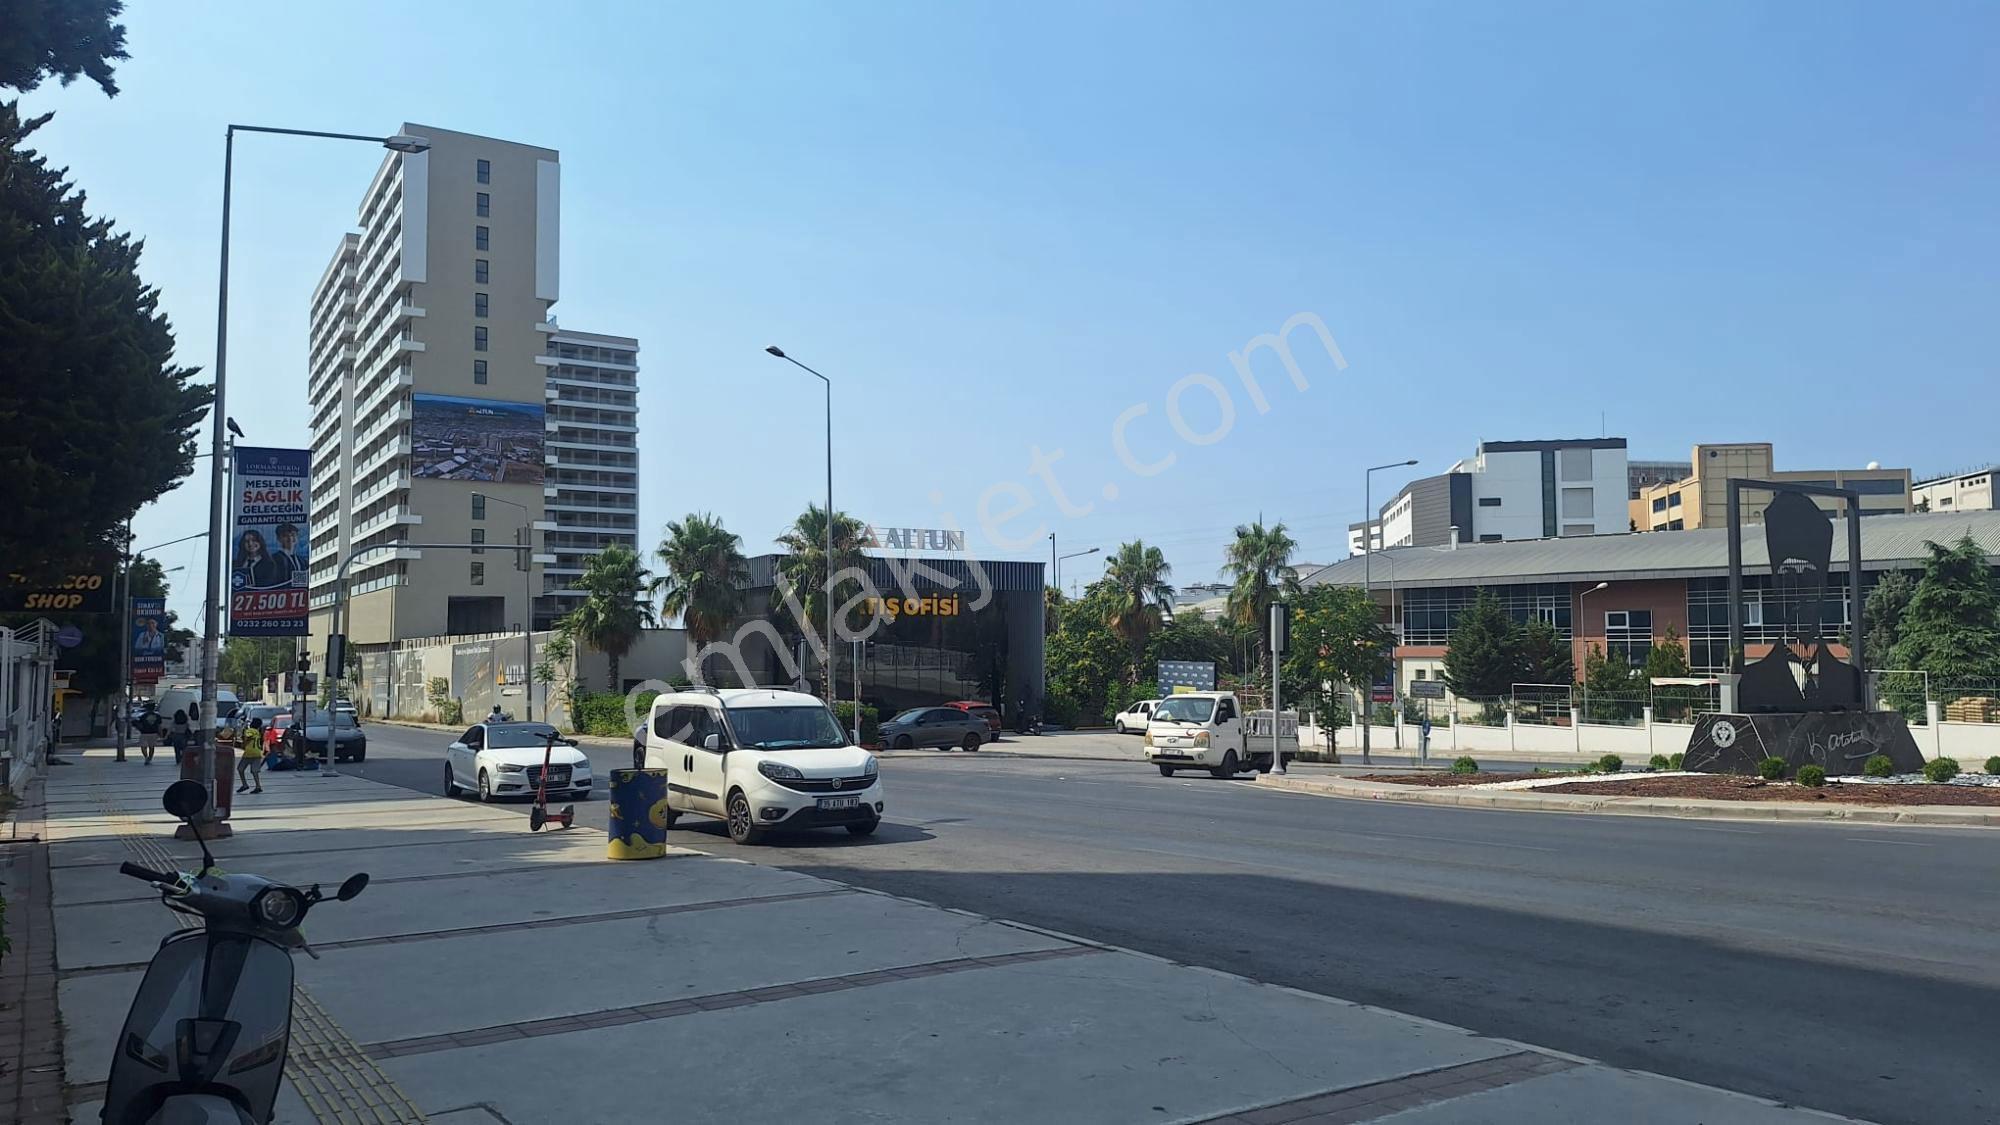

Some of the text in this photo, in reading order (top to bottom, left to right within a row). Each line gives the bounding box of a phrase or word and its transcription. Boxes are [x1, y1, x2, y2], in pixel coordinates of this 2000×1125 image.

[245, 478, 301, 489] MESLEĞİN
[243, 487, 303, 503] SAĞLIK
[242, 503, 303, 514] GELECEĞİN
[241, 515, 275, 524] GARANTİ
[886, 527, 965, 551] ALTUN
[24, 593, 83, 609] SHOP
[234, 591, 306, 611] 27.500 TL
[903, 592, 960, 616] OFİSİ
[237, 620, 260, 628] 0232
